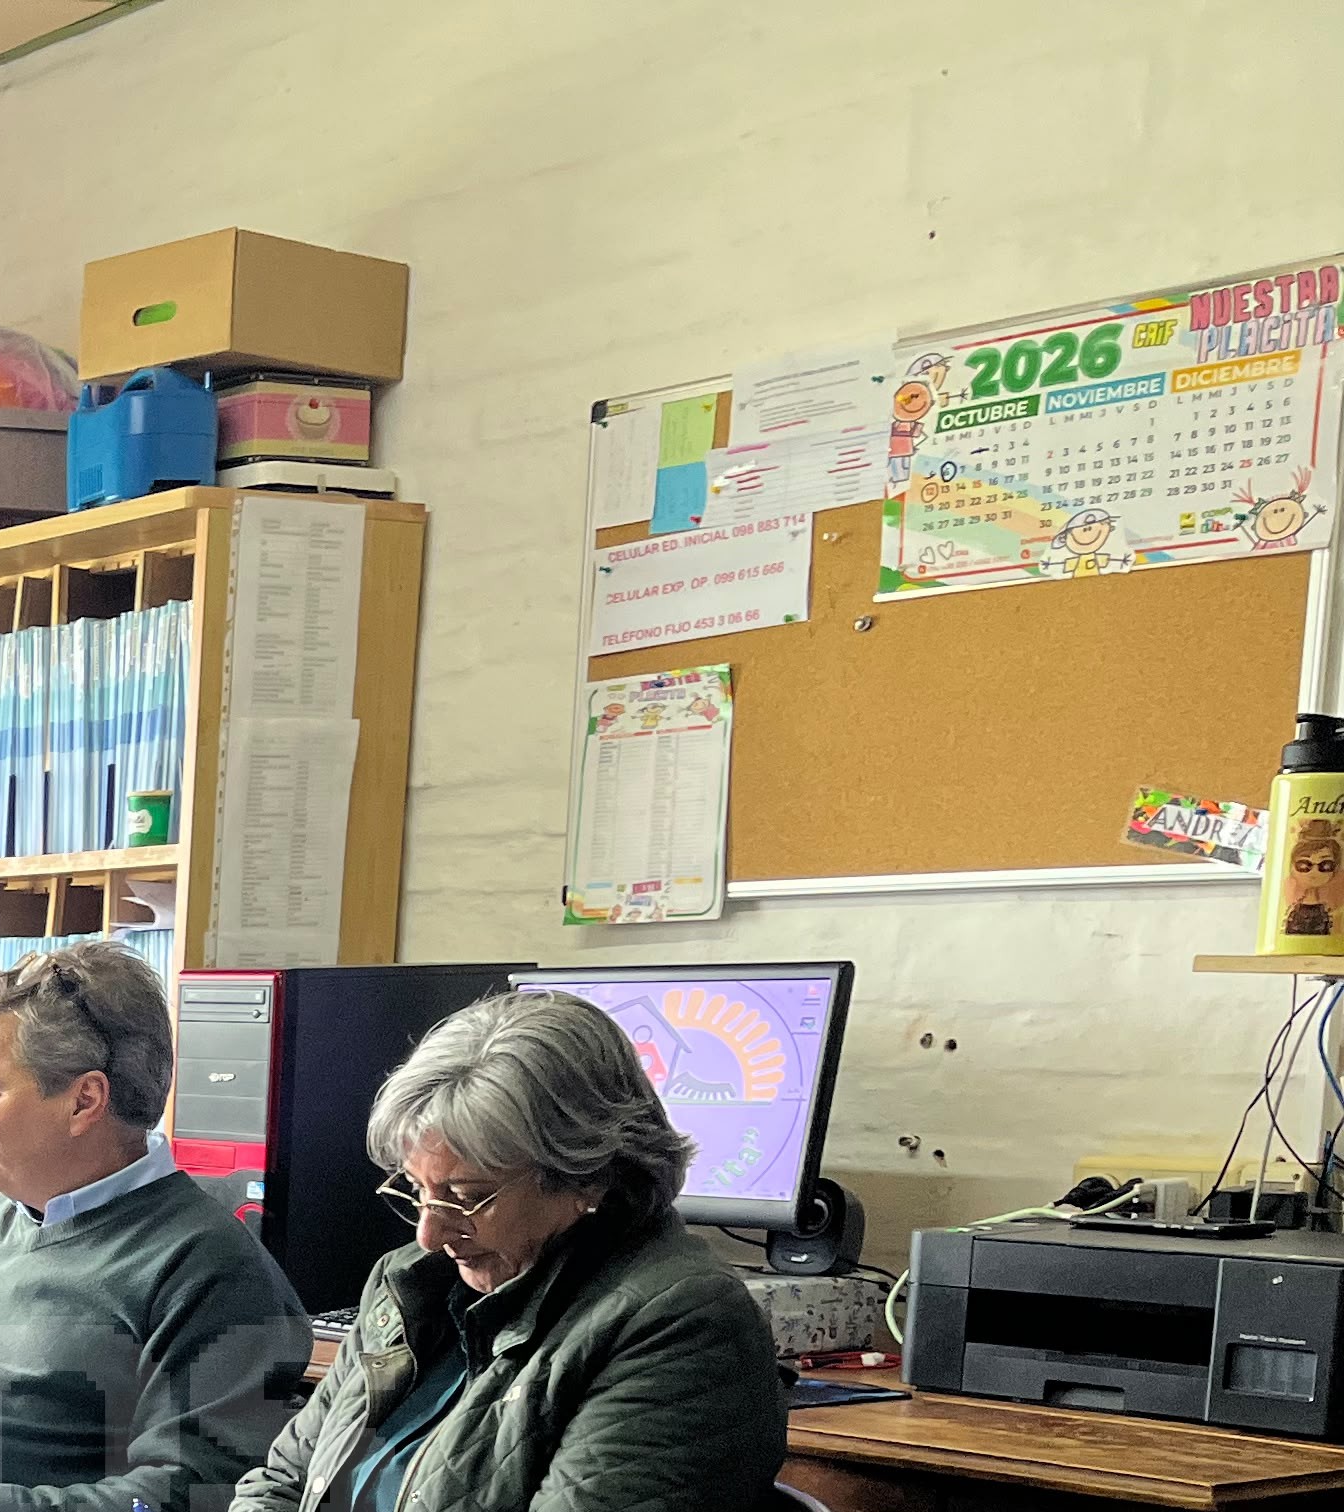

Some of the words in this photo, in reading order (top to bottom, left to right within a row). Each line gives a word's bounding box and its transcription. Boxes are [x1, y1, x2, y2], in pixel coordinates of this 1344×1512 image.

[1190, 266, 1339, 331] NUESTRA
[964, 323, 1125, 399] 2026
[1176, 354, 1296, 391] DICIEMBRE
[1048, 377, 1162, 411] NOVIEMBRE
[940, 402, 1028, 431] OCTUBRE
[608, 543, 659, 563] CELULAR
[684, 531, 729, 547] INICIAL
[732, 526, 755, 538] 098
[783, 514, 806, 528] 714
[606, 586, 659, 606] CELULAR
[664, 621, 691, 637] FIJO
[694, 616, 716, 630] 453
[717, 614, 726, 627] 3
